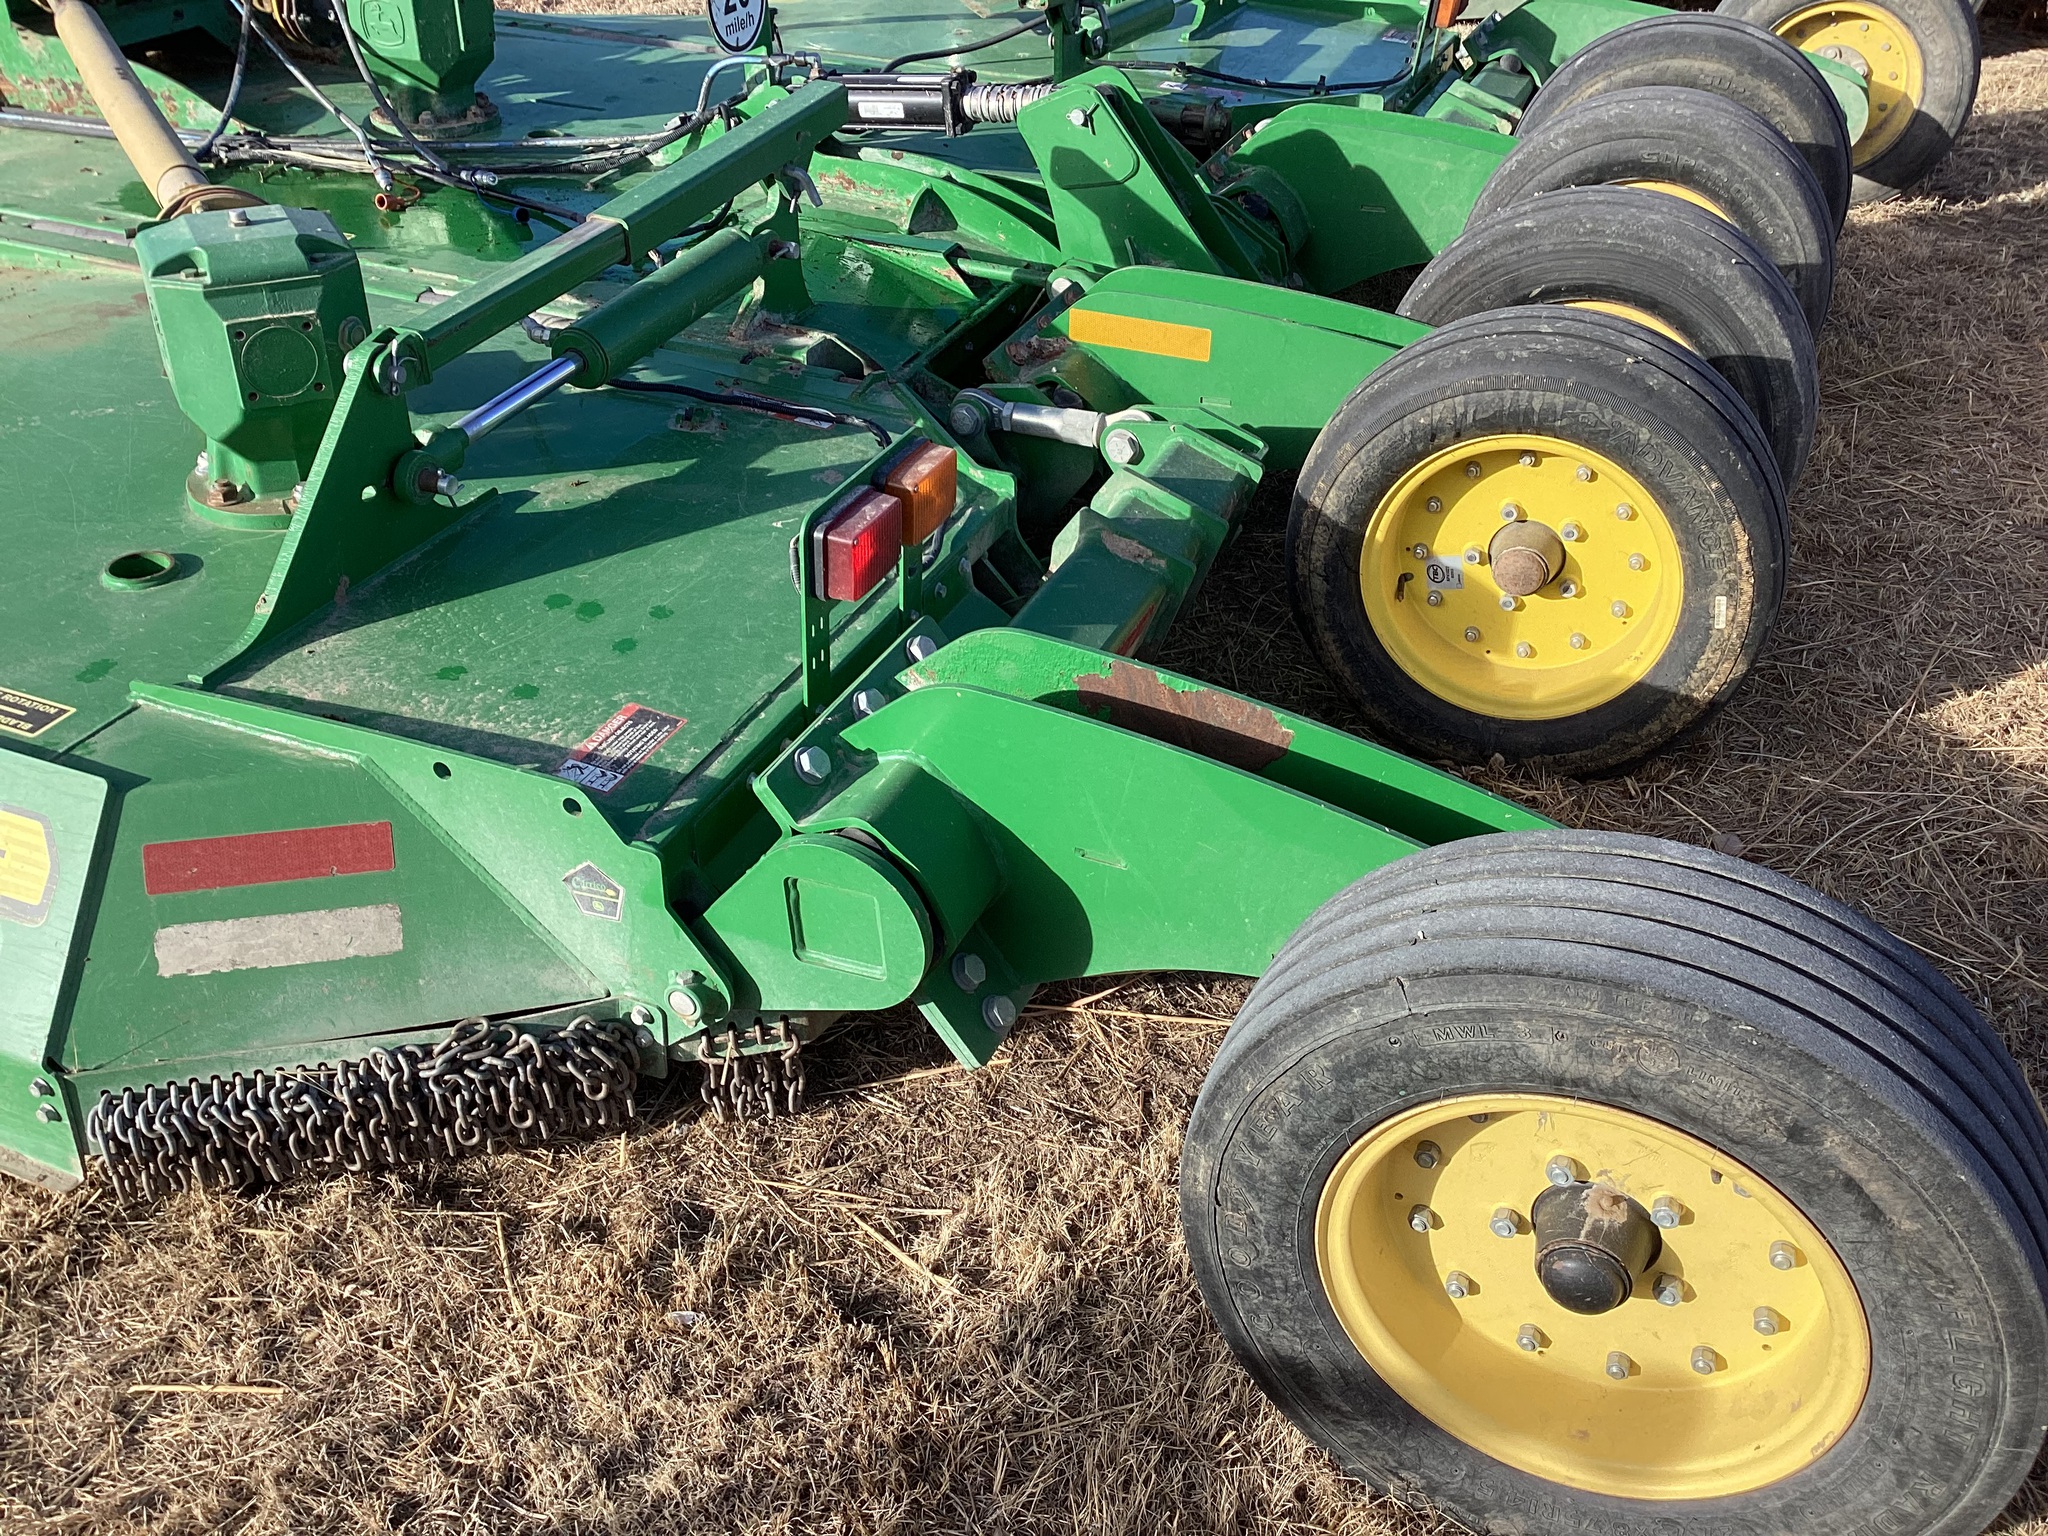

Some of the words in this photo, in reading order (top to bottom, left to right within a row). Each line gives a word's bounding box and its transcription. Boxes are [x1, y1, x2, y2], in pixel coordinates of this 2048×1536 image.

[725, 10, 755, 37] mile/h
[1609, 429, 1727, 570] ADVANCE
[1, 693, 59, 714] ROTATION
[595, 714, 628, 742] DANGER
[1432, 1023, 1496, 1041] MWL
